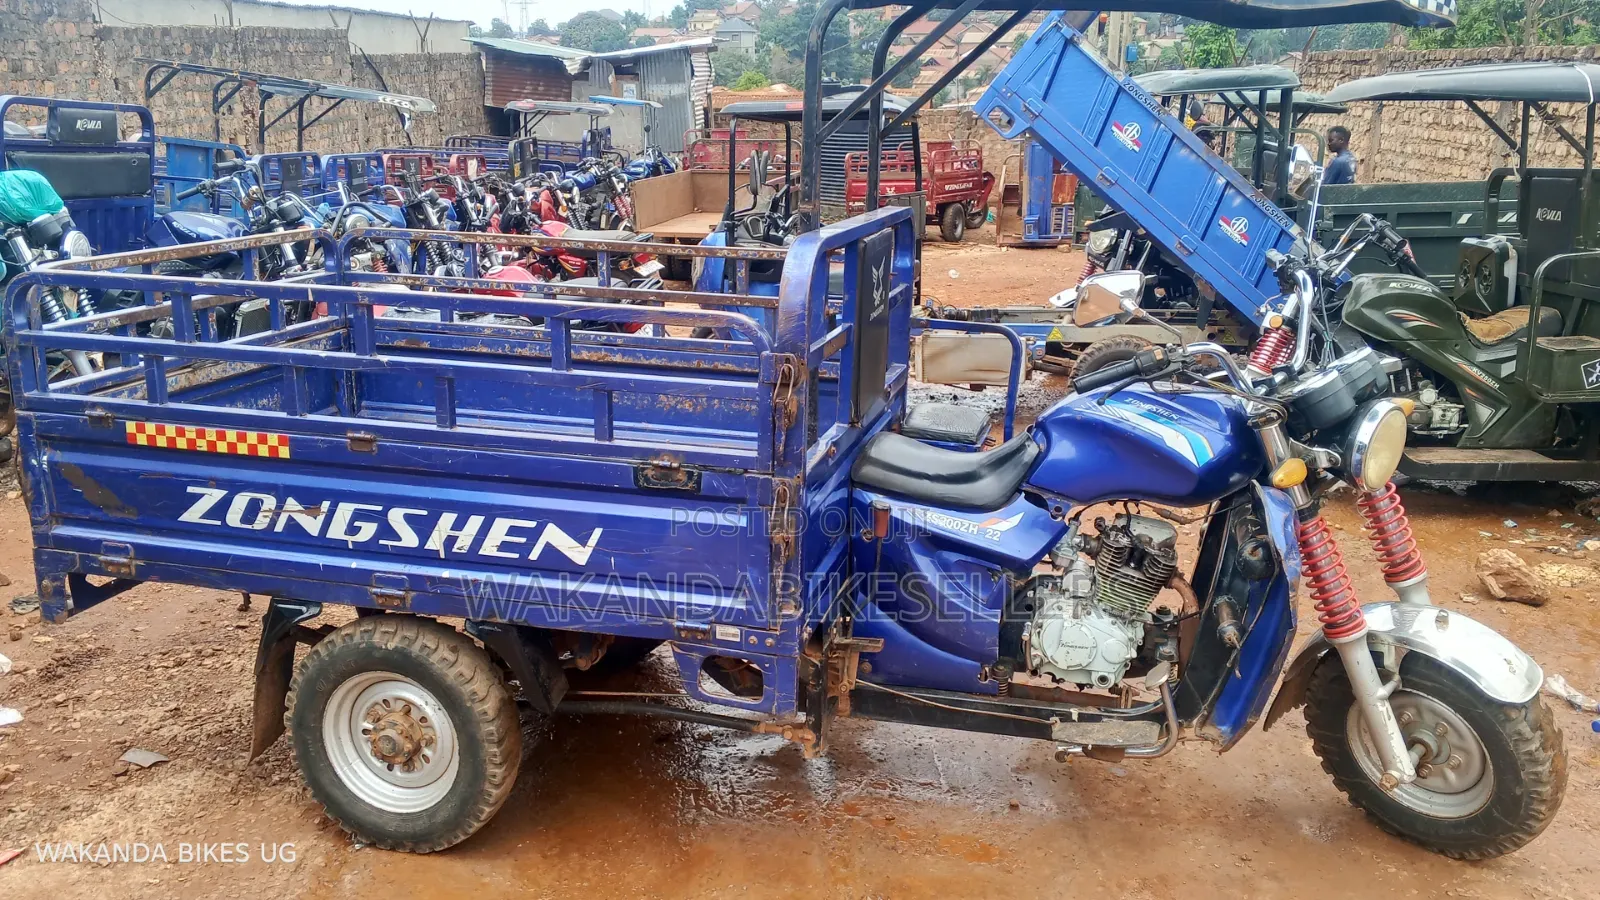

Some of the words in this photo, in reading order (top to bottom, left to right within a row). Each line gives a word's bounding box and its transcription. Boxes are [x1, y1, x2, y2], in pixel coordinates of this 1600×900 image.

[1123, 82, 1163, 117] ZONGSHEN
[1124, 397, 1181, 420] ZONGSHEN
[177, 485, 604, 567] ZONGSHEN
